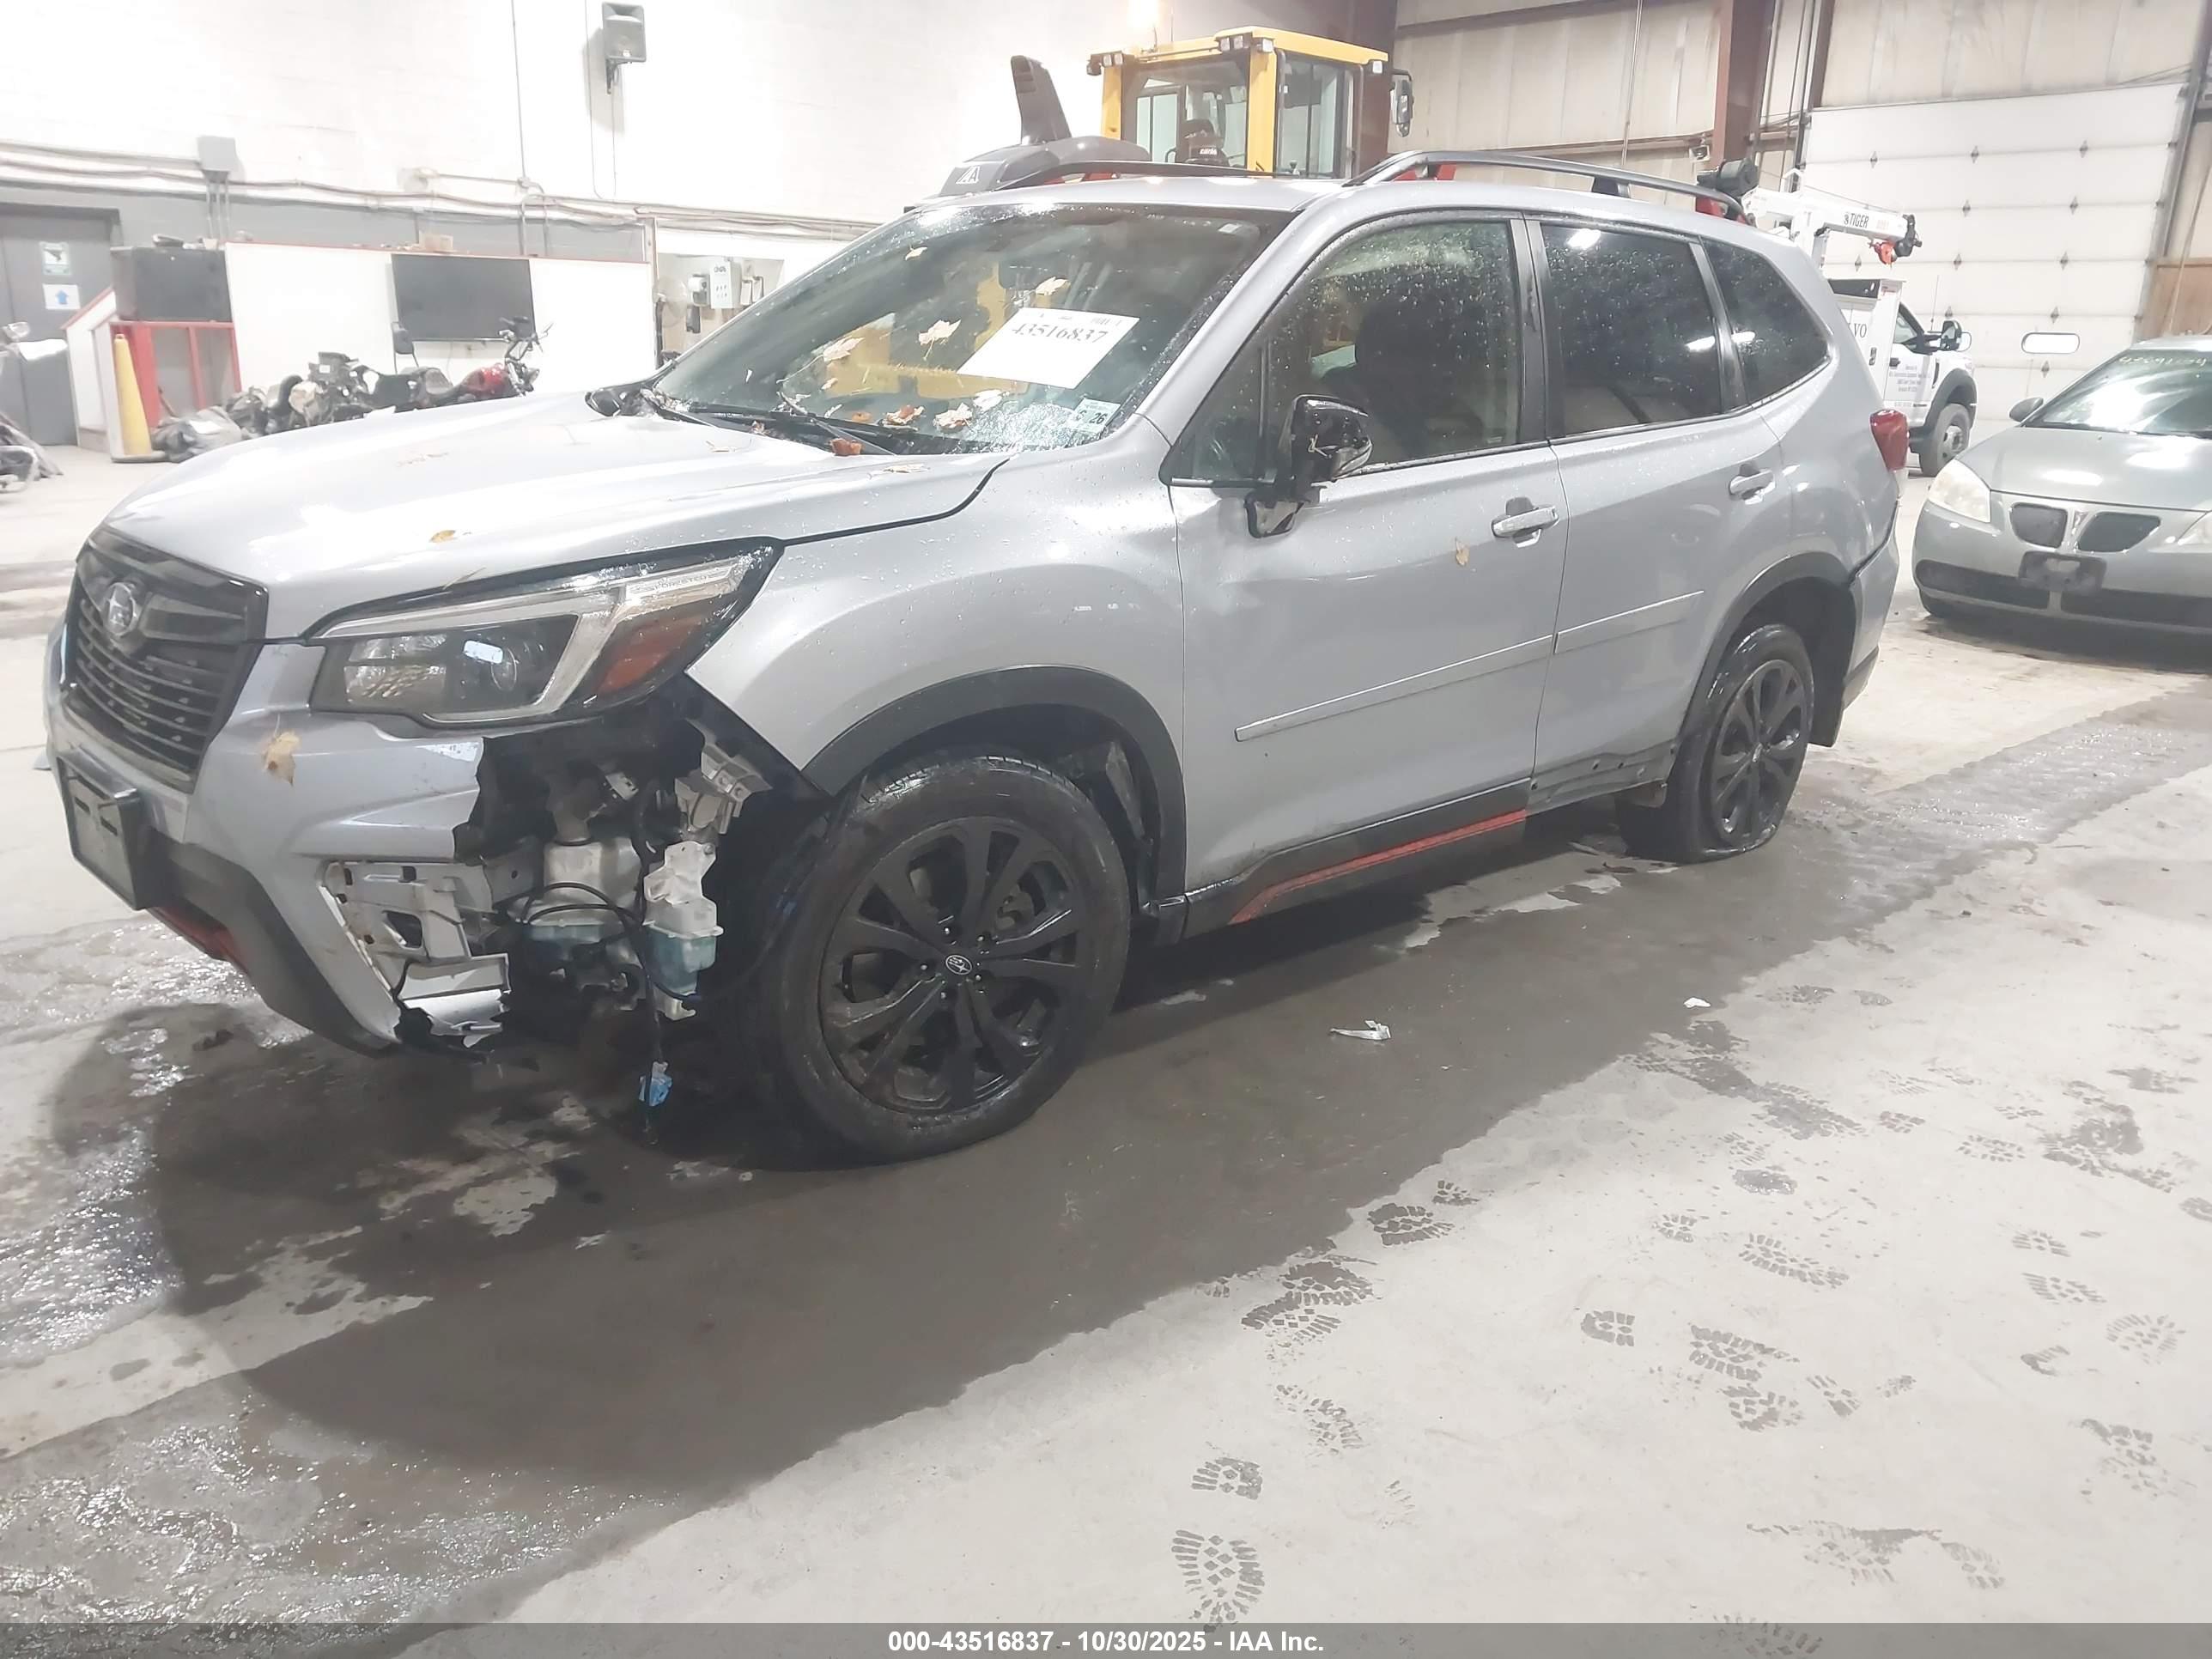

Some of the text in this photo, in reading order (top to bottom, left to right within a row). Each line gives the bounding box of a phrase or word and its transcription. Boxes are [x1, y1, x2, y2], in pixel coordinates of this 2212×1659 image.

[1850, 213, 1869, 228] TIGER
[1012, 323, 1109, 343] 43516837
[1089, 412, 1108, 424] 26
